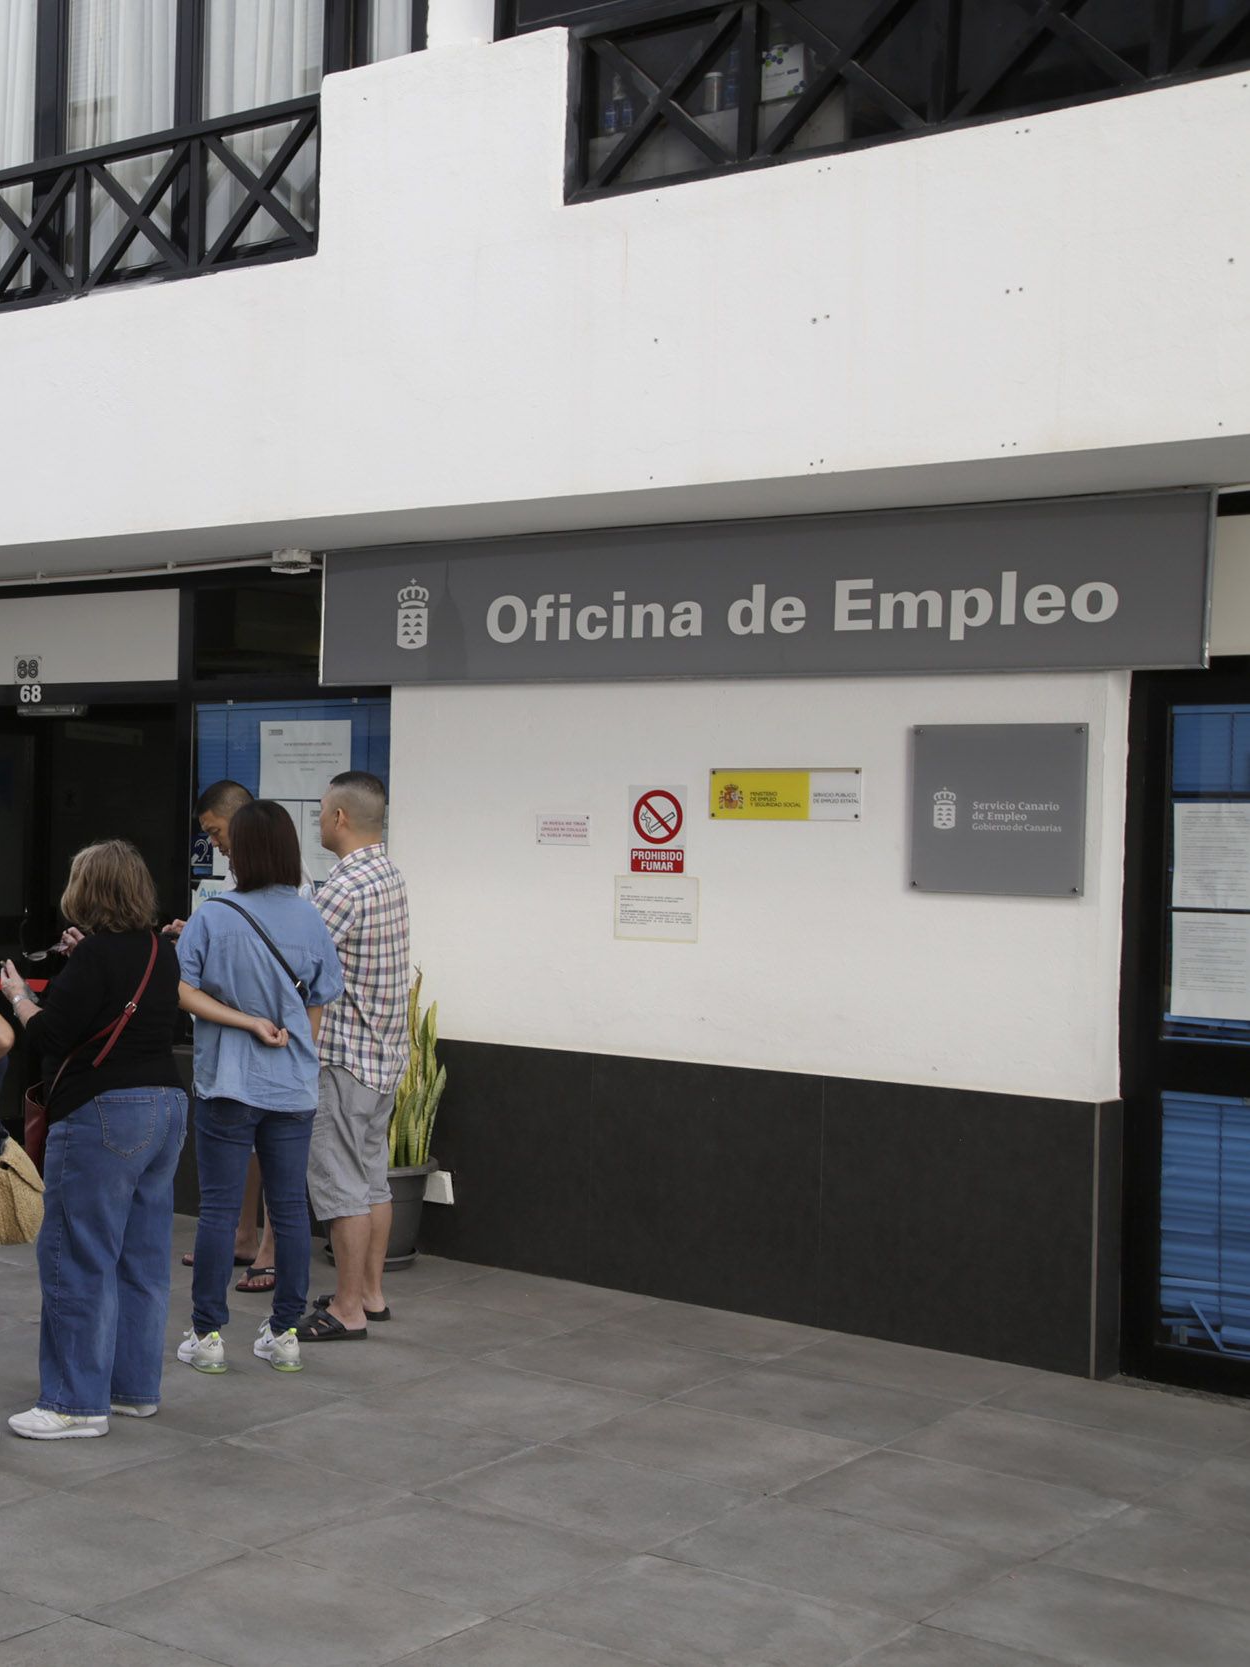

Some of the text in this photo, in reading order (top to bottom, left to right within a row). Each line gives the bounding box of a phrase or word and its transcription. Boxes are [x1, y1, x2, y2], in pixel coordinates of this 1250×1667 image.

[486, 571, 1119, 643] Oficina de Empleo
[20, 684, 42, 703] 68
[972, 800, 1060, 812] Servicio Canario
[972, 811, 1028, 823] de Empleo
[972, 822, 1062, 833] Gobierno de Canarias
[632, 851, 683, 861] PROHIBIDO
[640, 861, 674, 871] FUMAR
